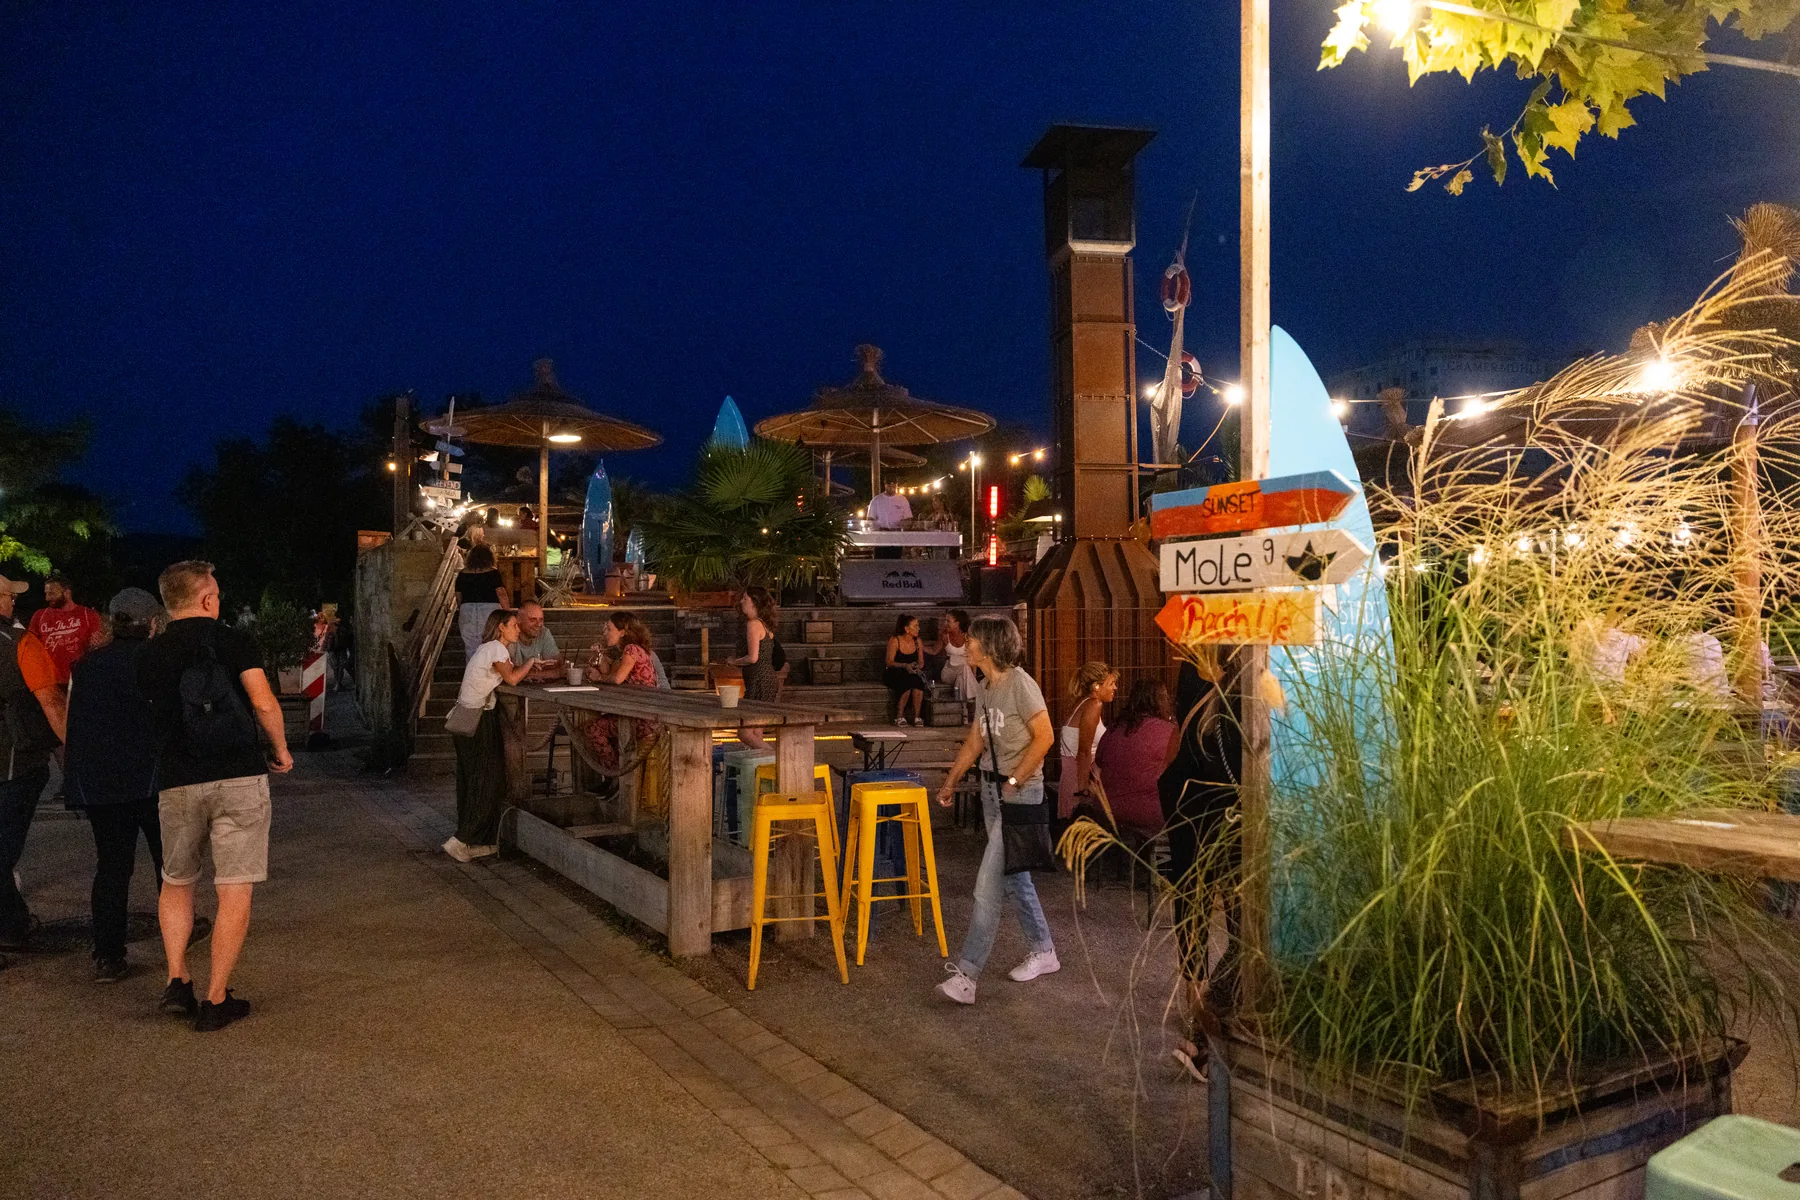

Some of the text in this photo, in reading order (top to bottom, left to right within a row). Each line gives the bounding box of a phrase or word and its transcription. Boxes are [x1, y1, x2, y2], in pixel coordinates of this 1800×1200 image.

[1202, 489, 1261, 518] SUNSET
[1175, 545, 1252, 587] Mole
[882, 578, 923, 590] Red Bull
[1181, 596, 1250, 639] Beach
[1339, 600, 1380, 626] STADT
